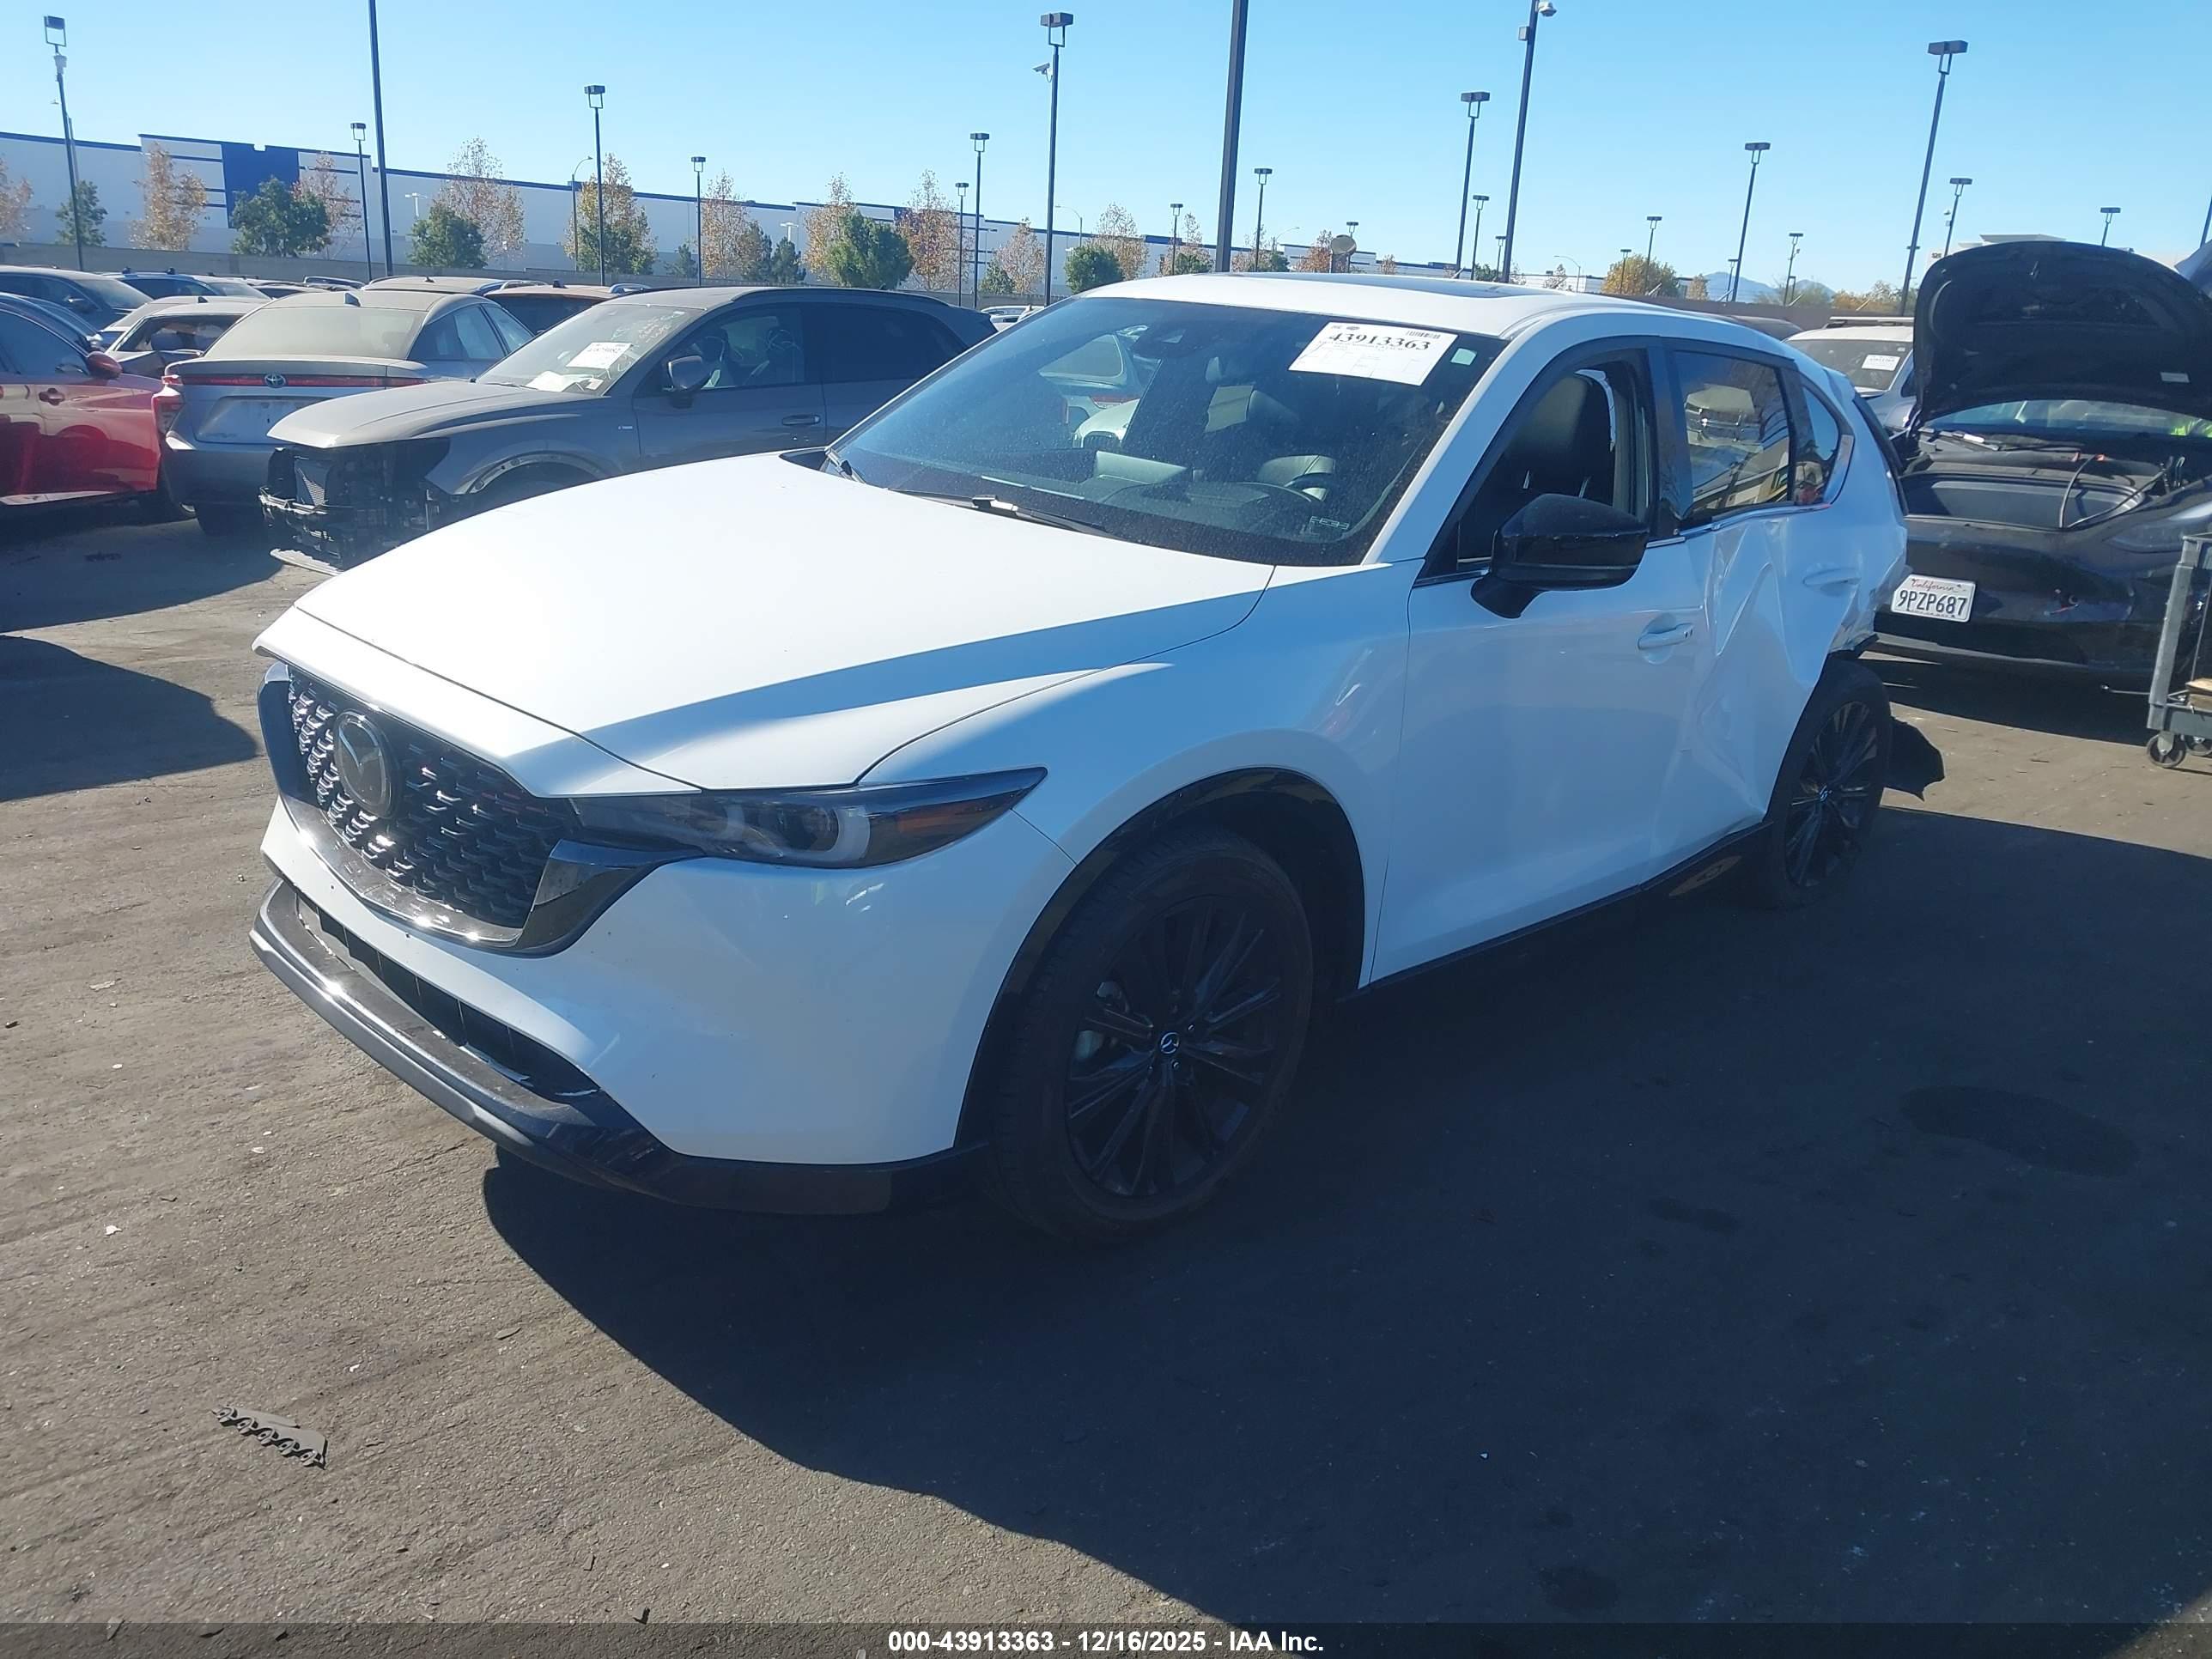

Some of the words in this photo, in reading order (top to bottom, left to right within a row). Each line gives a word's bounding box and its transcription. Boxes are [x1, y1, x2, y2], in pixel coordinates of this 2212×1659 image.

[1328, 332, 1431, 350] 43913363
[1911, 578, 1956, 592] California
[1897, 589, 1968, 617] 9PZP687
